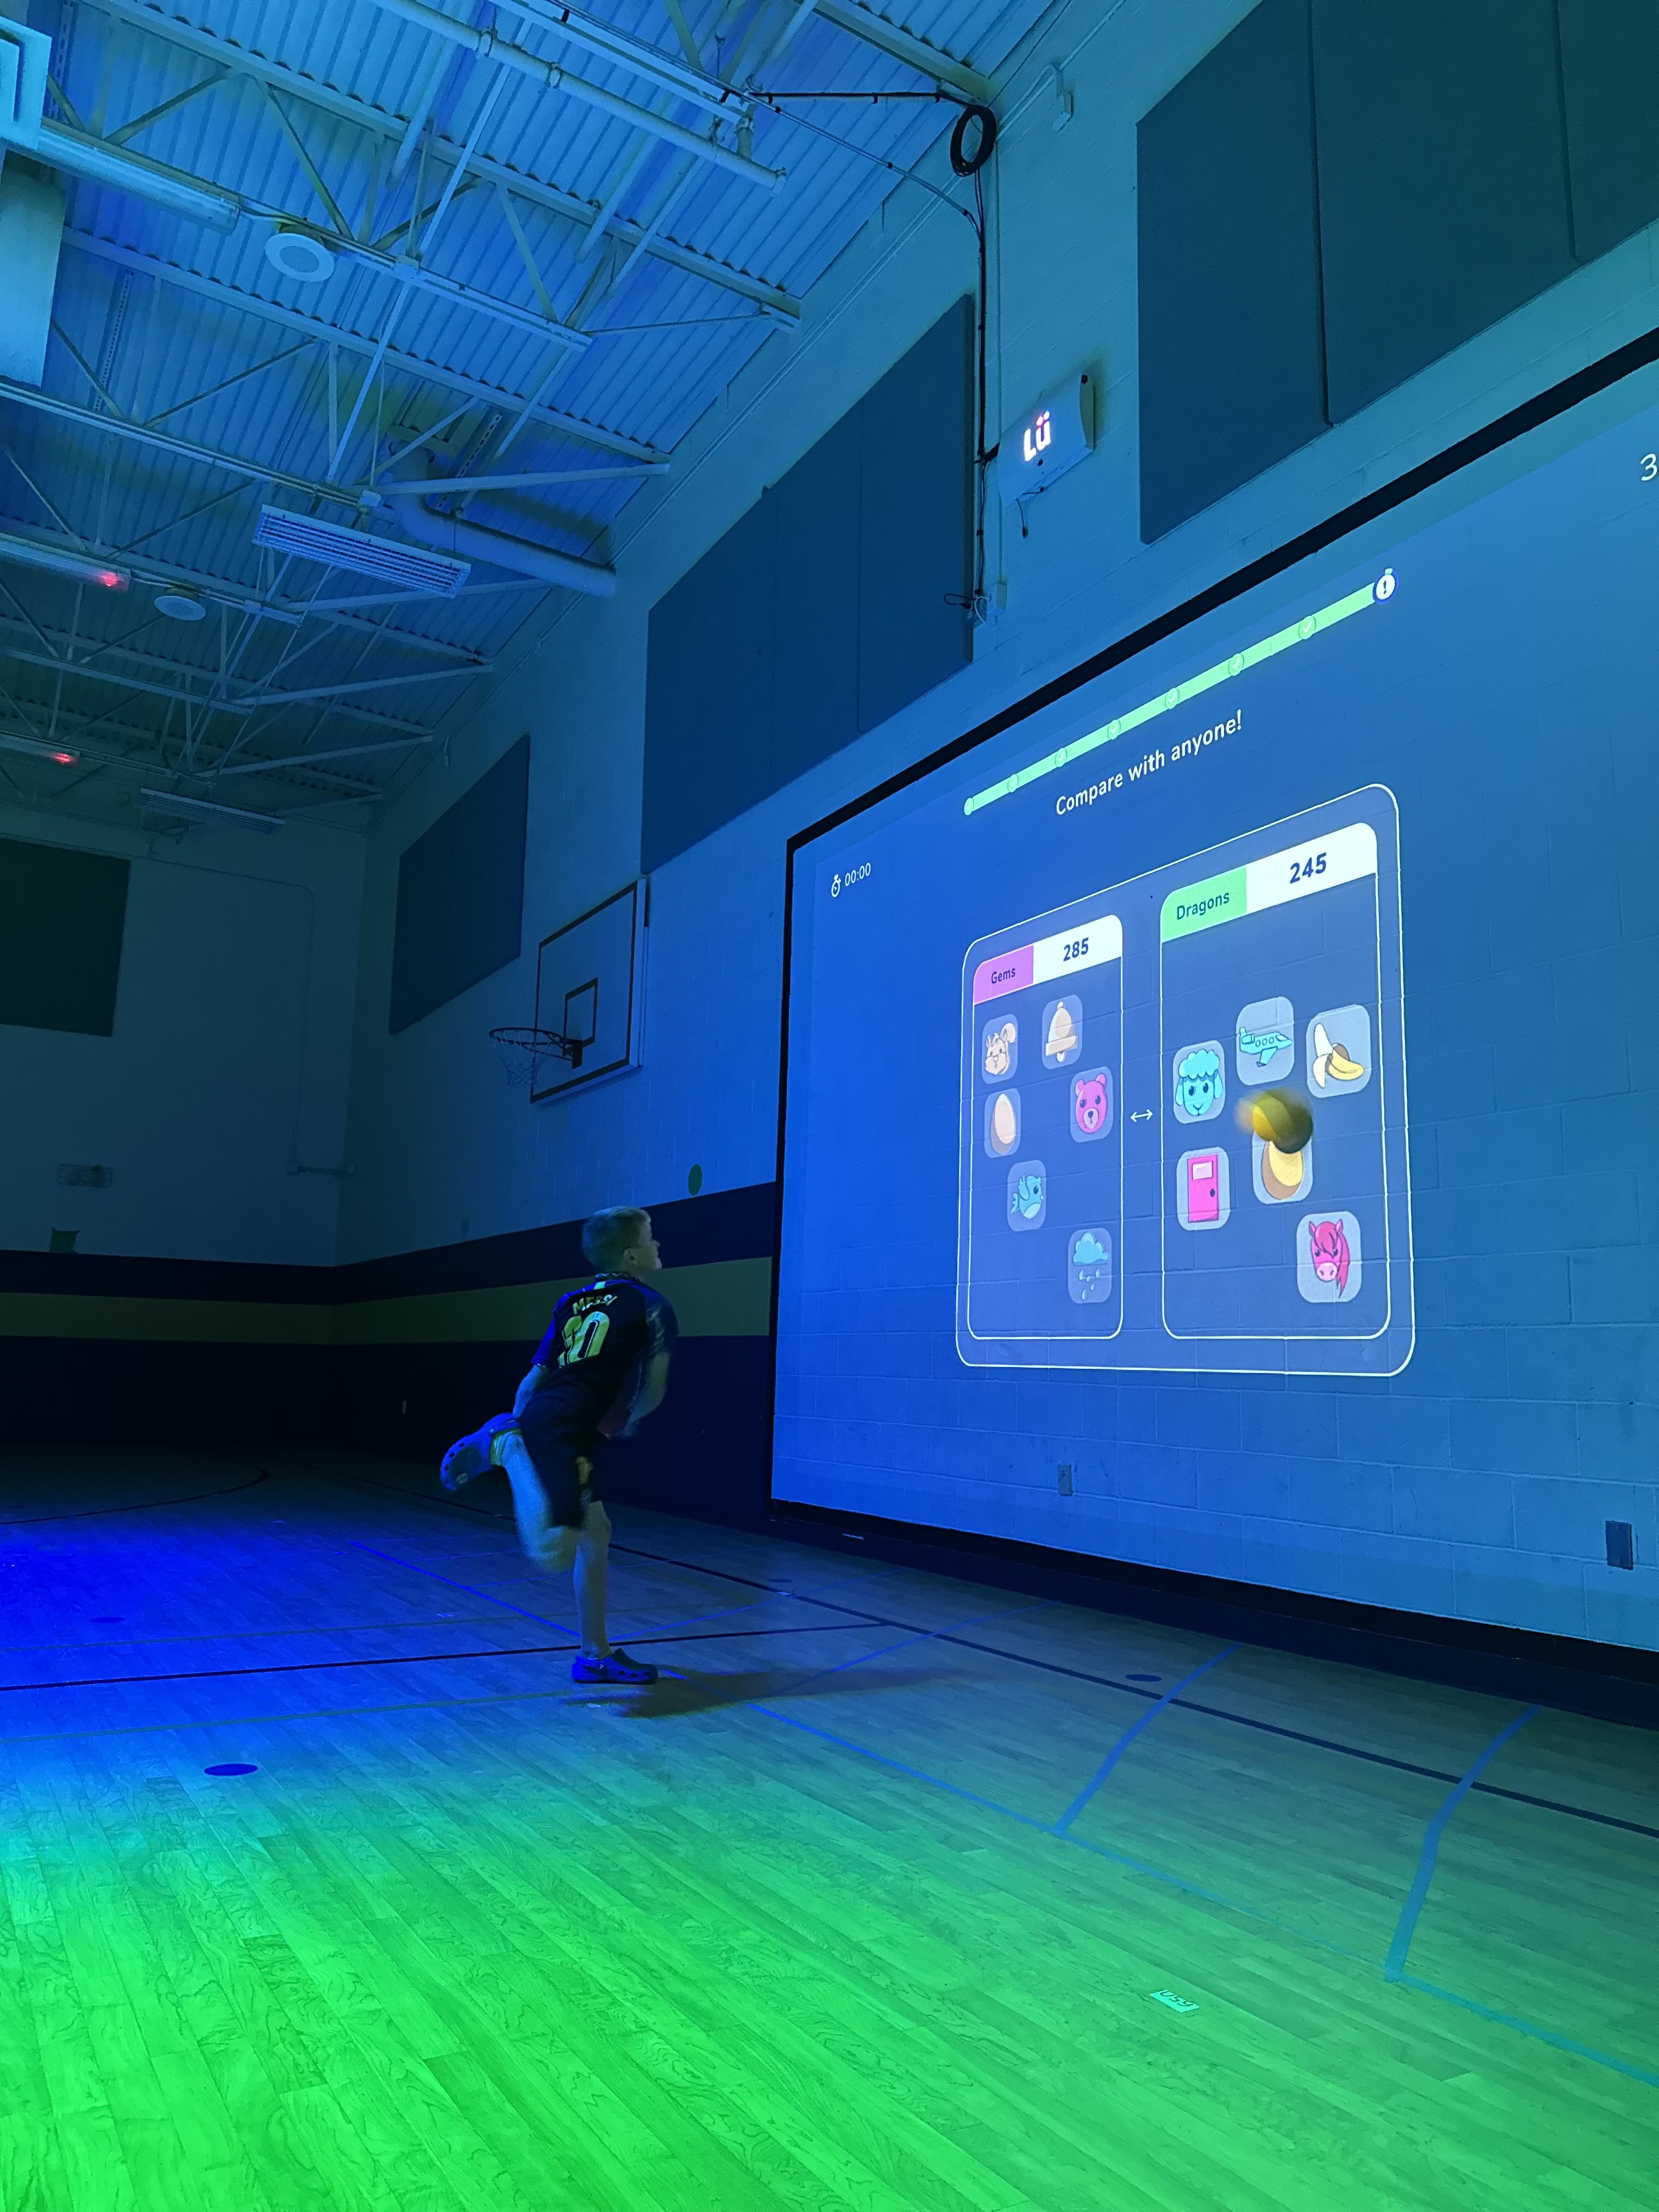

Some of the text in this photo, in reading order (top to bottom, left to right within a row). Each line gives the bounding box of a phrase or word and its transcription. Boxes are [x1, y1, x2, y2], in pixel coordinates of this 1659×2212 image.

[1024, 411, 1051, 461] Lü
[1056, 709, 1242, 815] Compare with anyone!
[844, 862, 871, 886] 00:00
[1177, 851, 1327, 921] Dragons 245
[991, 936, 1090, 984] Gems 285
[572, 1294, 618, 1316] MESSI
[557, 1311, 611, 1369] 10
